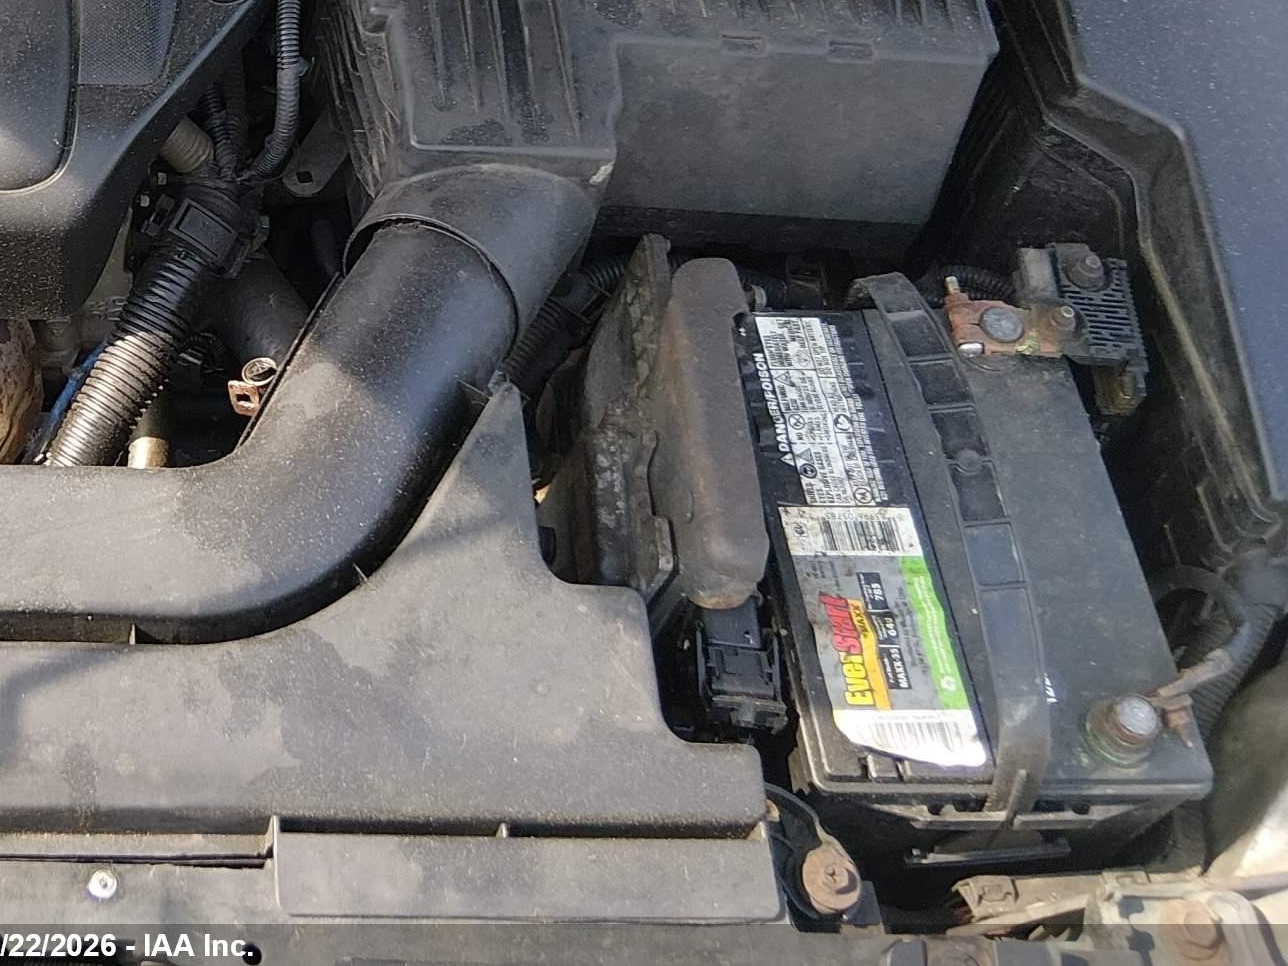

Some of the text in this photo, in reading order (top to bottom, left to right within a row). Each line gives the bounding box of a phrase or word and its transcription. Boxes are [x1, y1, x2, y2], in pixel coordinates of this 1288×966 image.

[752, 353, 791, 451] DANGER/POISON
[795, 432, 803, 440] NO
[870, 583, 885, 600] 785
[817, 593, 874, 704] EverStart
